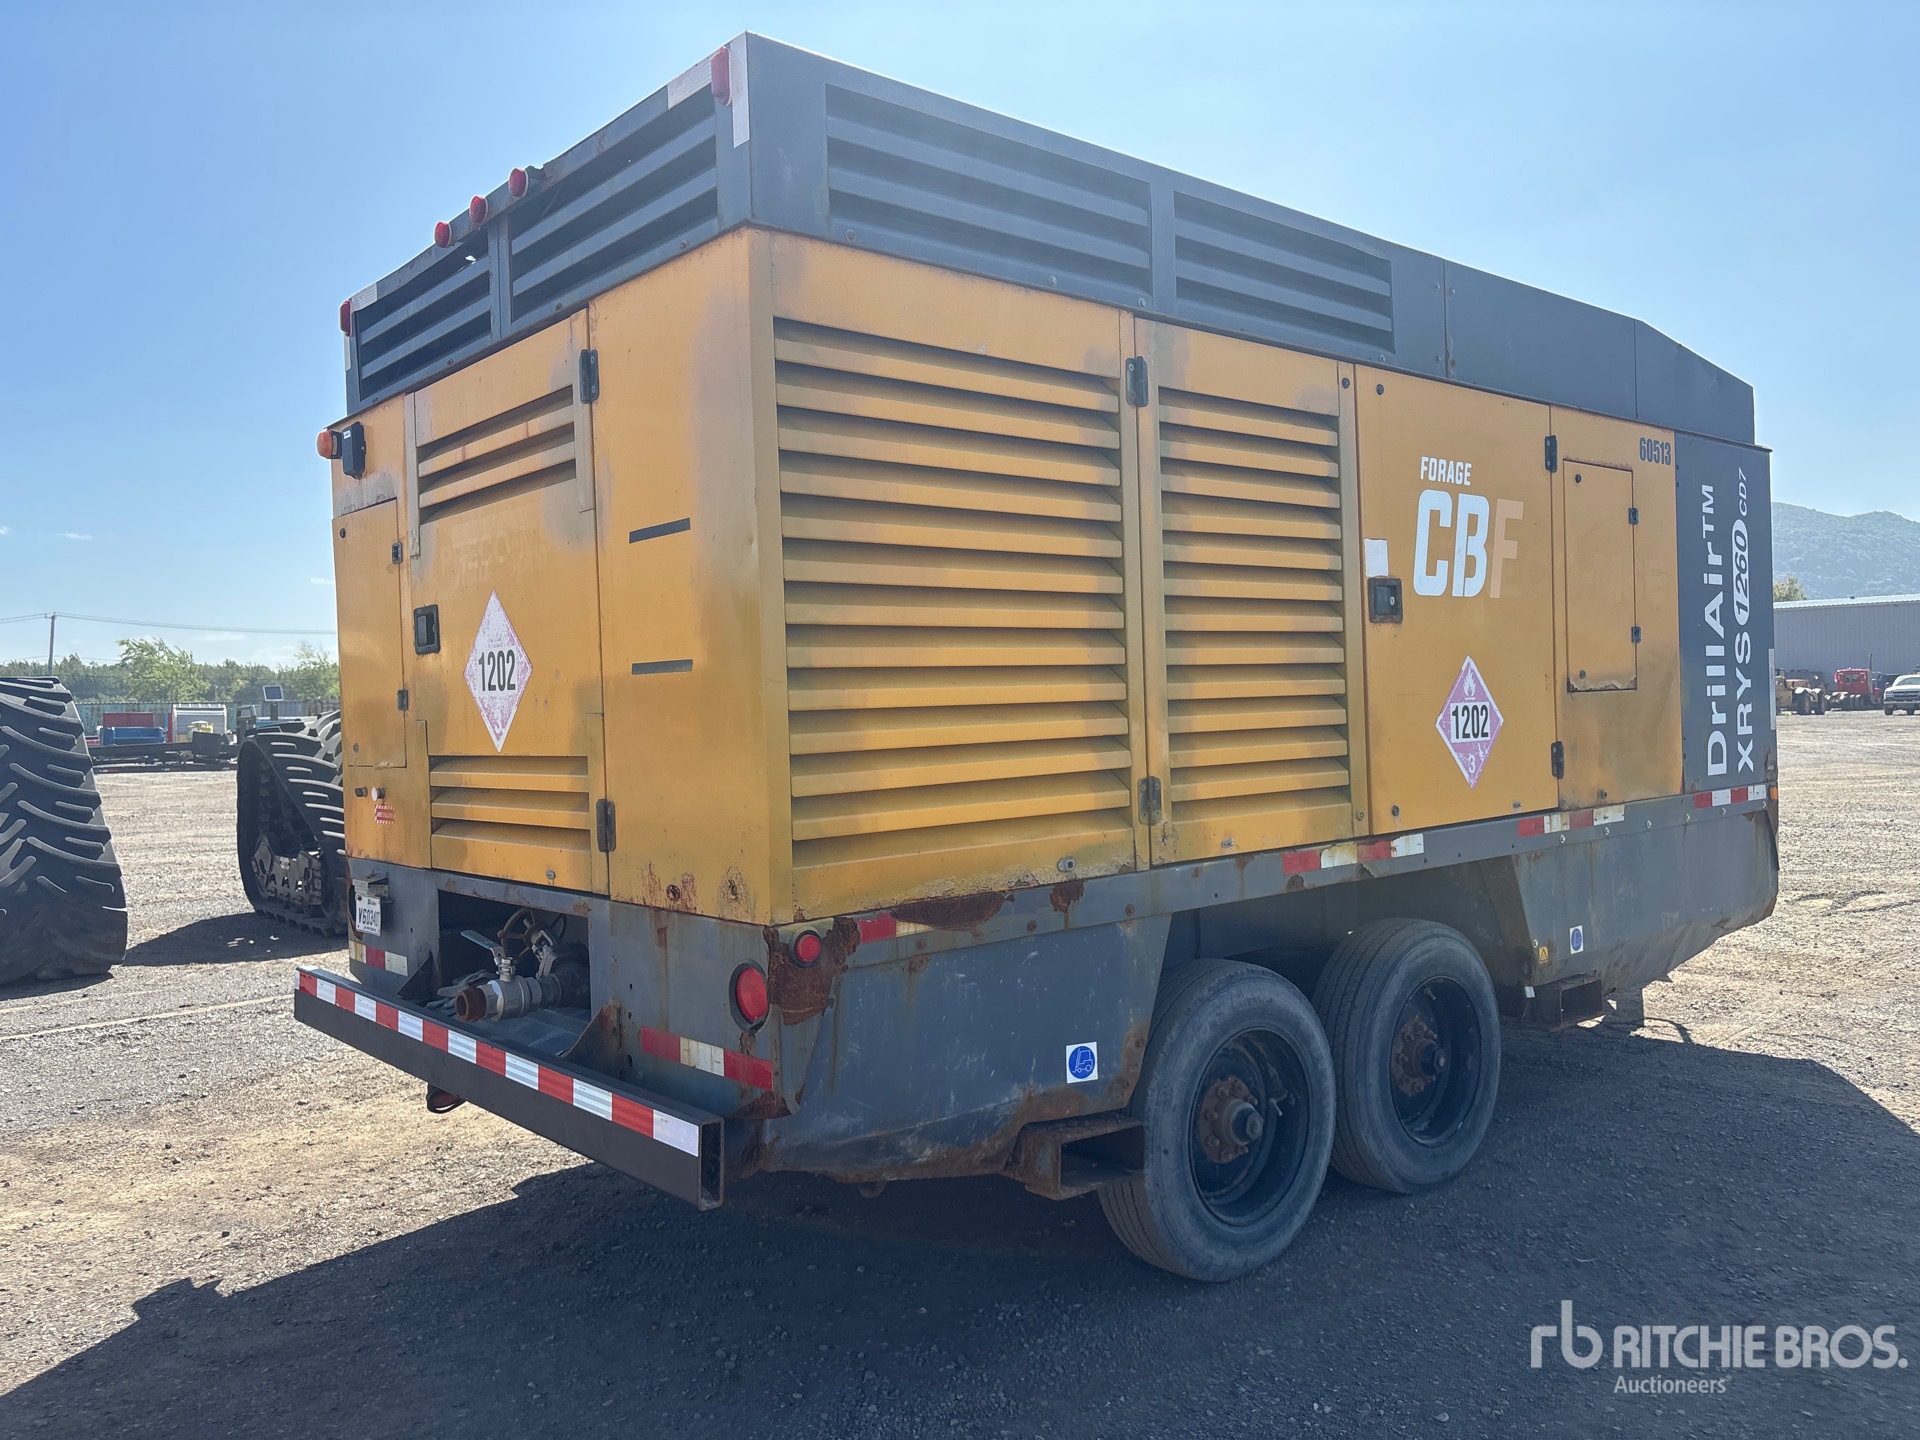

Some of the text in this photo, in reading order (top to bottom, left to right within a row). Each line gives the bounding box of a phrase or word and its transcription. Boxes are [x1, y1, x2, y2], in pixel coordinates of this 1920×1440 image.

[1639, 437, 1671, 465] 60513
[1420, 456, 1472, 486] FORAGE
[1733, 467, 1754, 774] XRYS 1260 CD7
[478, 649, 516, 692] 1202
[1452, 704, 1489, 739] 1202
[1468, 753, 1476, 774] 3
